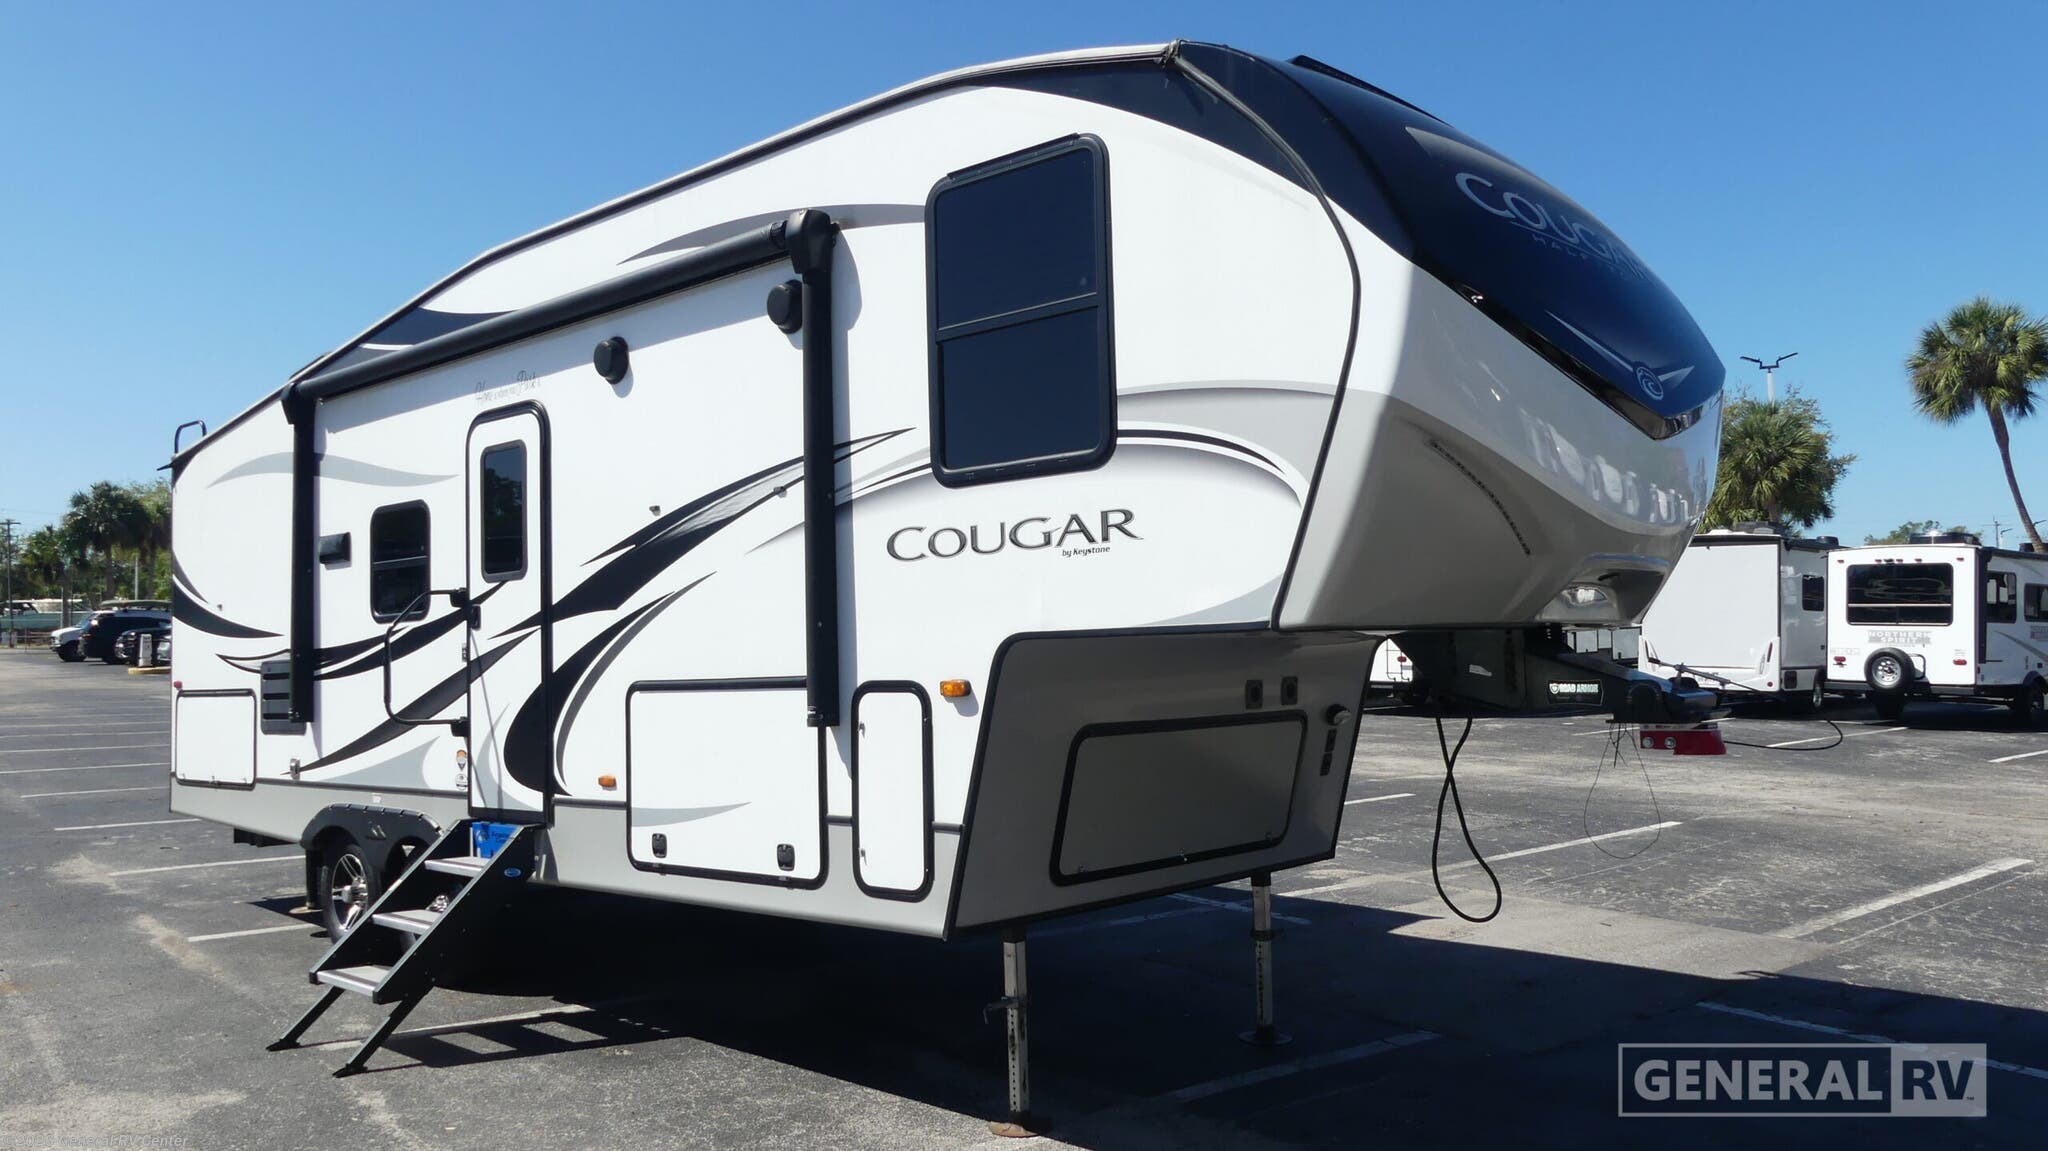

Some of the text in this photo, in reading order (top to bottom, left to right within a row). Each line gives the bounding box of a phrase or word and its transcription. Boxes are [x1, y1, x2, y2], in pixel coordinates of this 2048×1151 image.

[1455, 172, 1655, 282] COUGAR
[886, 508, 1144, 561] COUGAR
[1062, 546, 1111, 557] by Keystone
